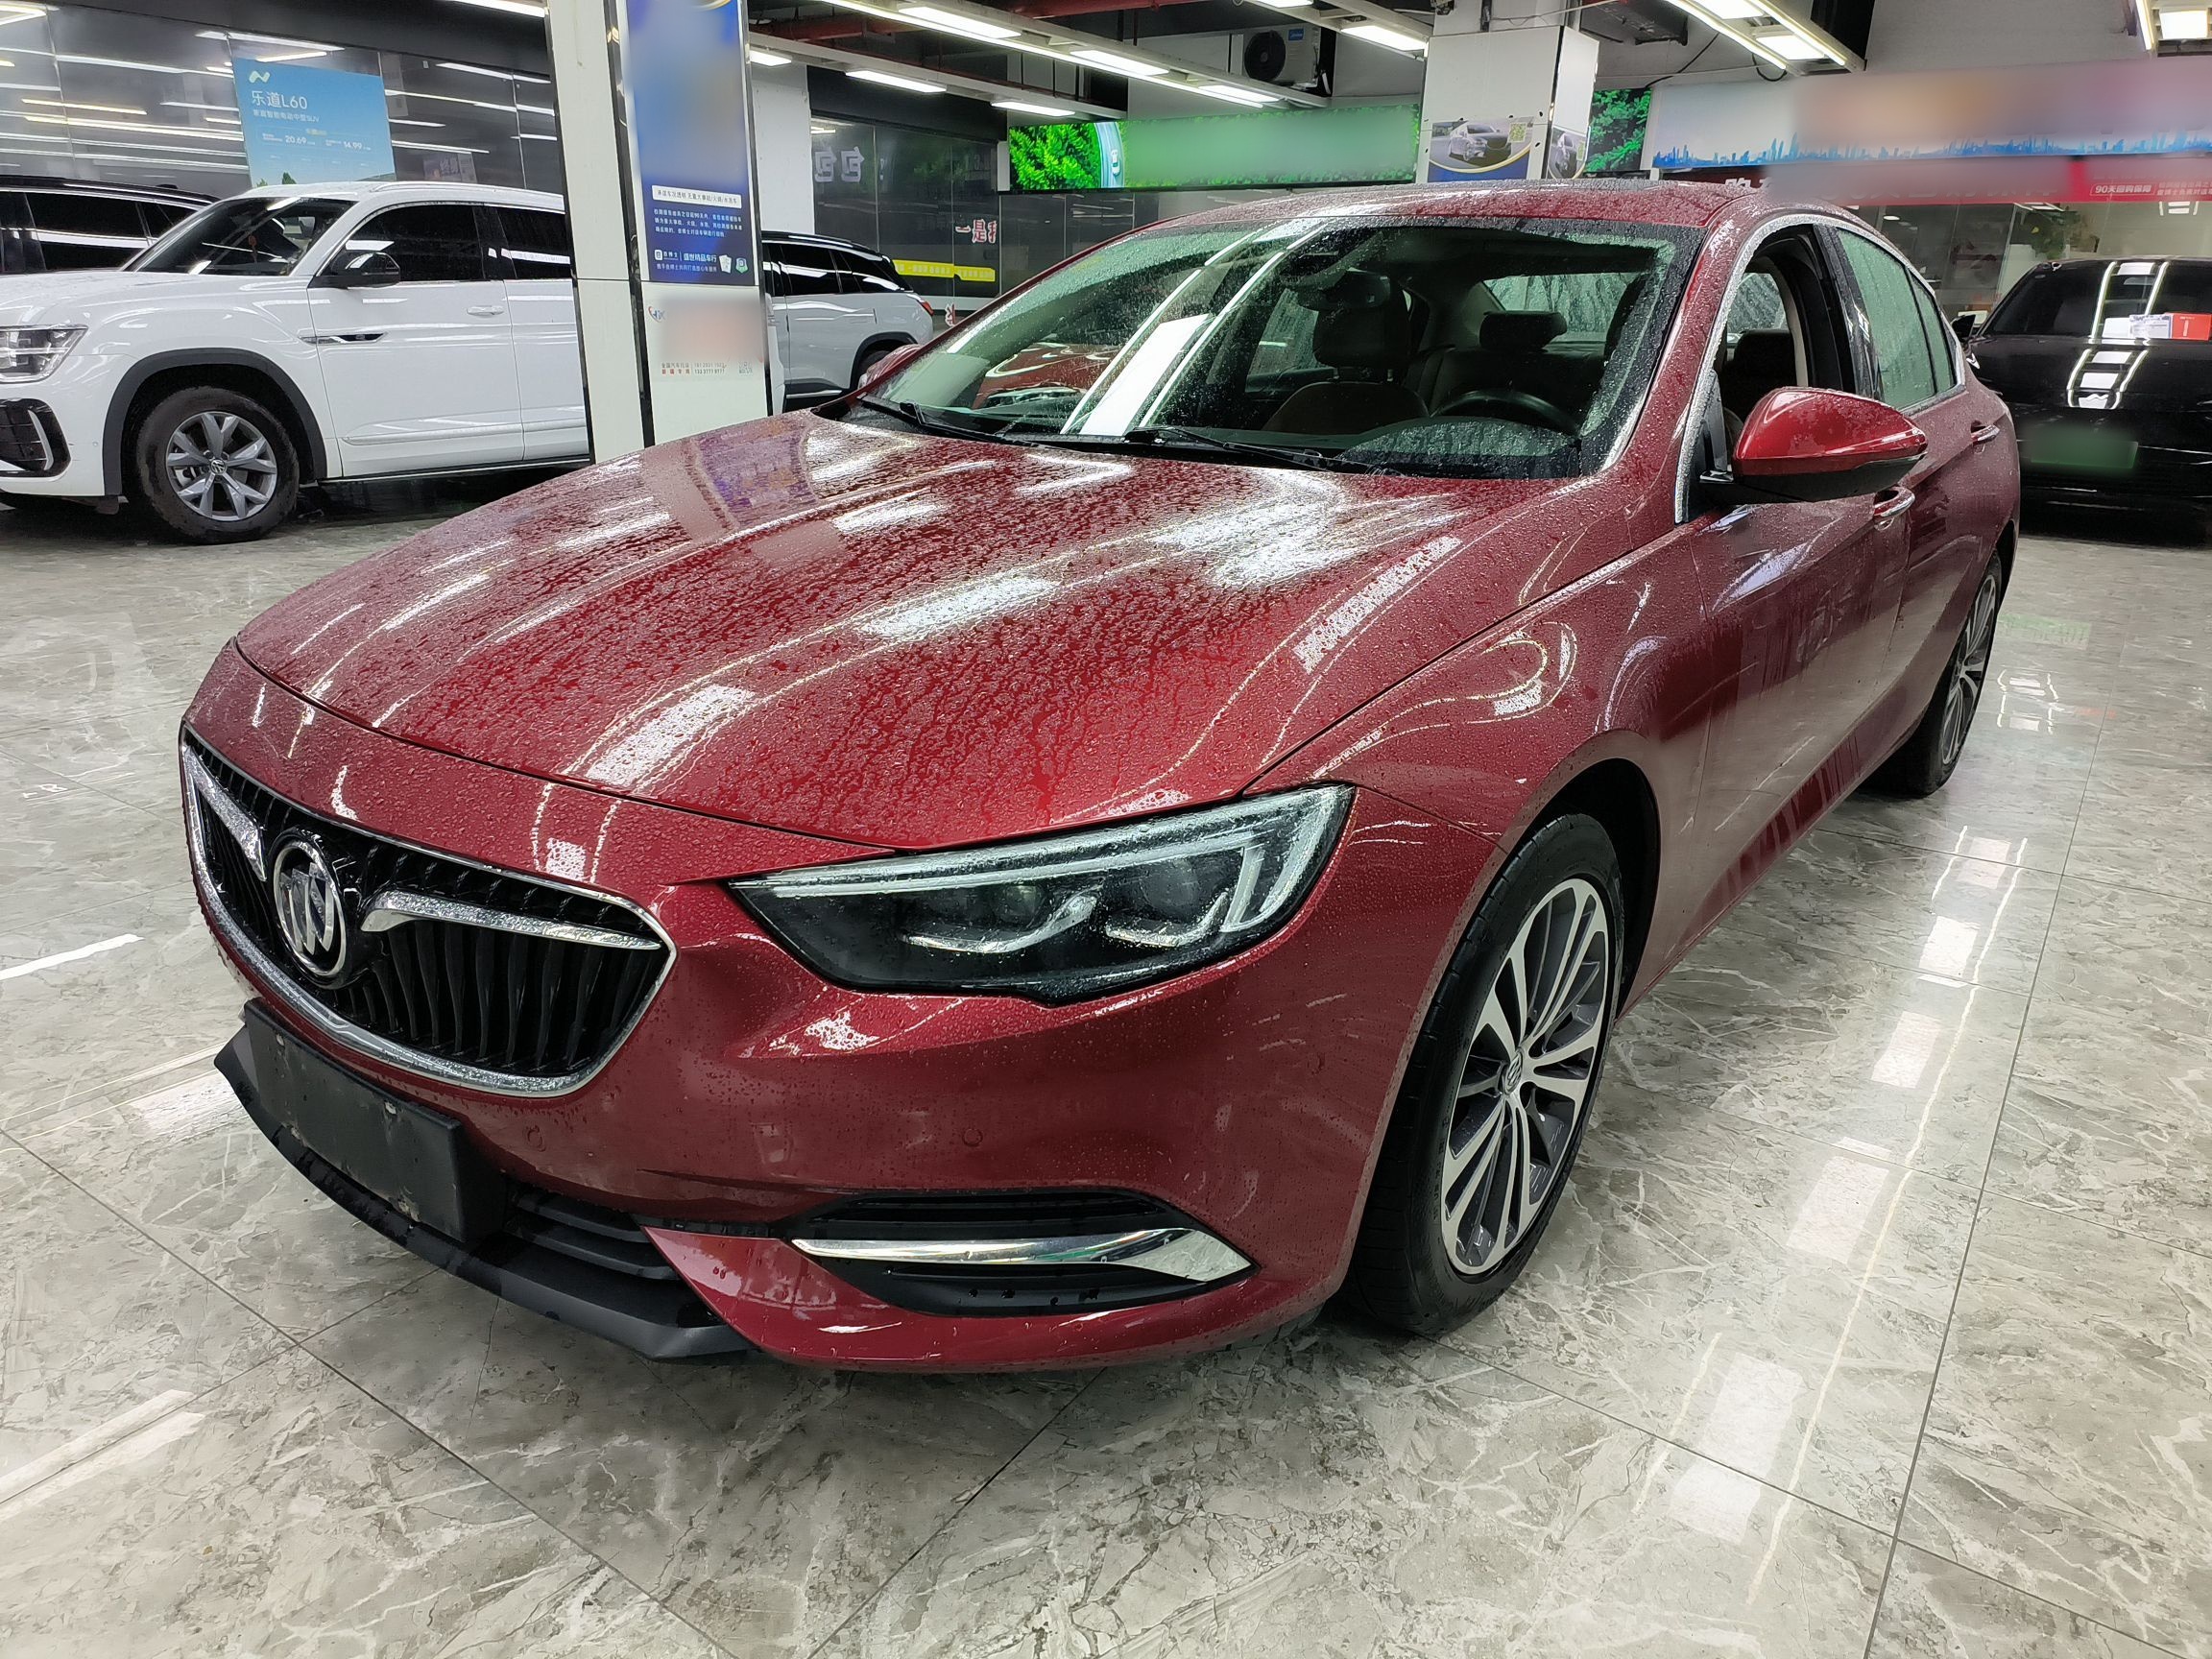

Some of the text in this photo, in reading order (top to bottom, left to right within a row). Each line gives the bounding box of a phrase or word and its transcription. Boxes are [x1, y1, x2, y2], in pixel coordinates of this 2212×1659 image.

[252, 90, 308, 109] 乐道L60
[285, 134, 307, 144] 20.69
[2095, 184, 2152, 194] 90天回购保障
